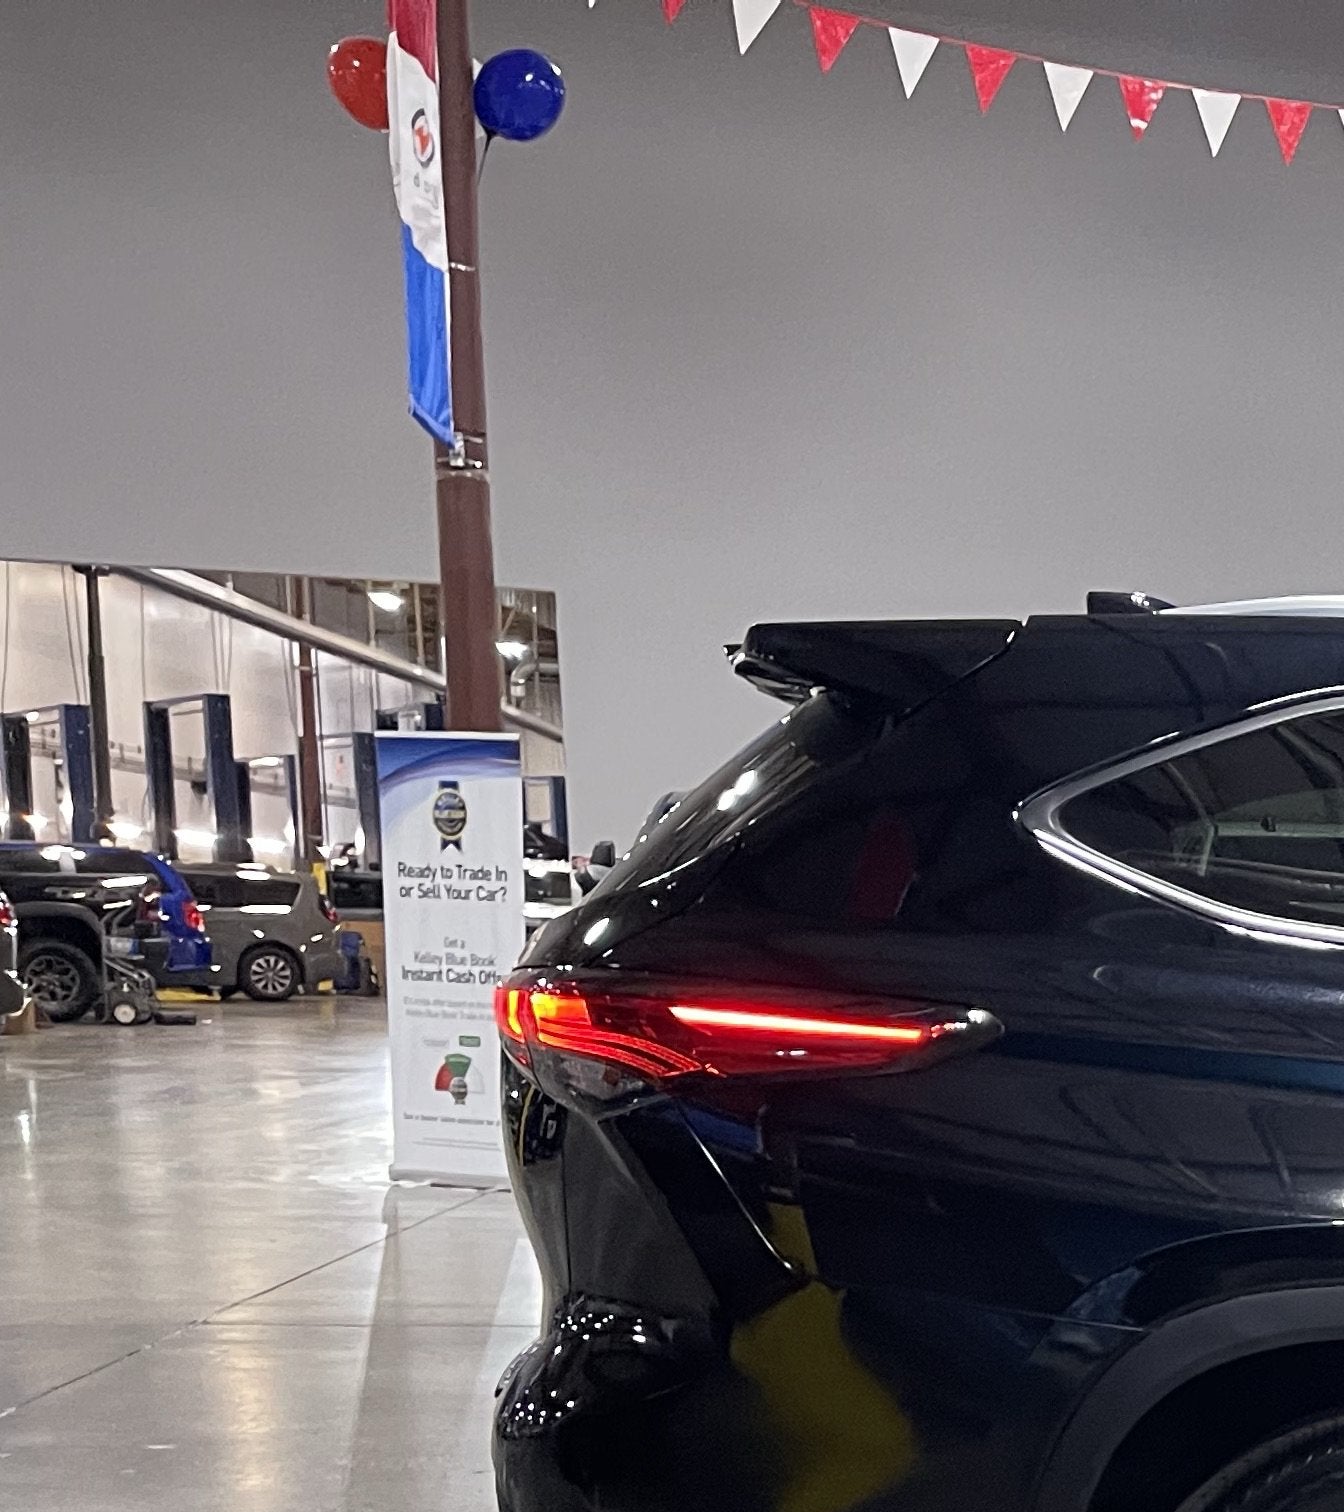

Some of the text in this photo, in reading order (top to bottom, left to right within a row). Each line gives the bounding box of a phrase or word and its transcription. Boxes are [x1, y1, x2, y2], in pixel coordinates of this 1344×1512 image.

[397, 861, 507, 883] Ready to Trade In
[399, 883, 507, 902] or Sell Your Car?
[401, 965, 443, 982] Instant
[446, 968, 476, 984] Cash
